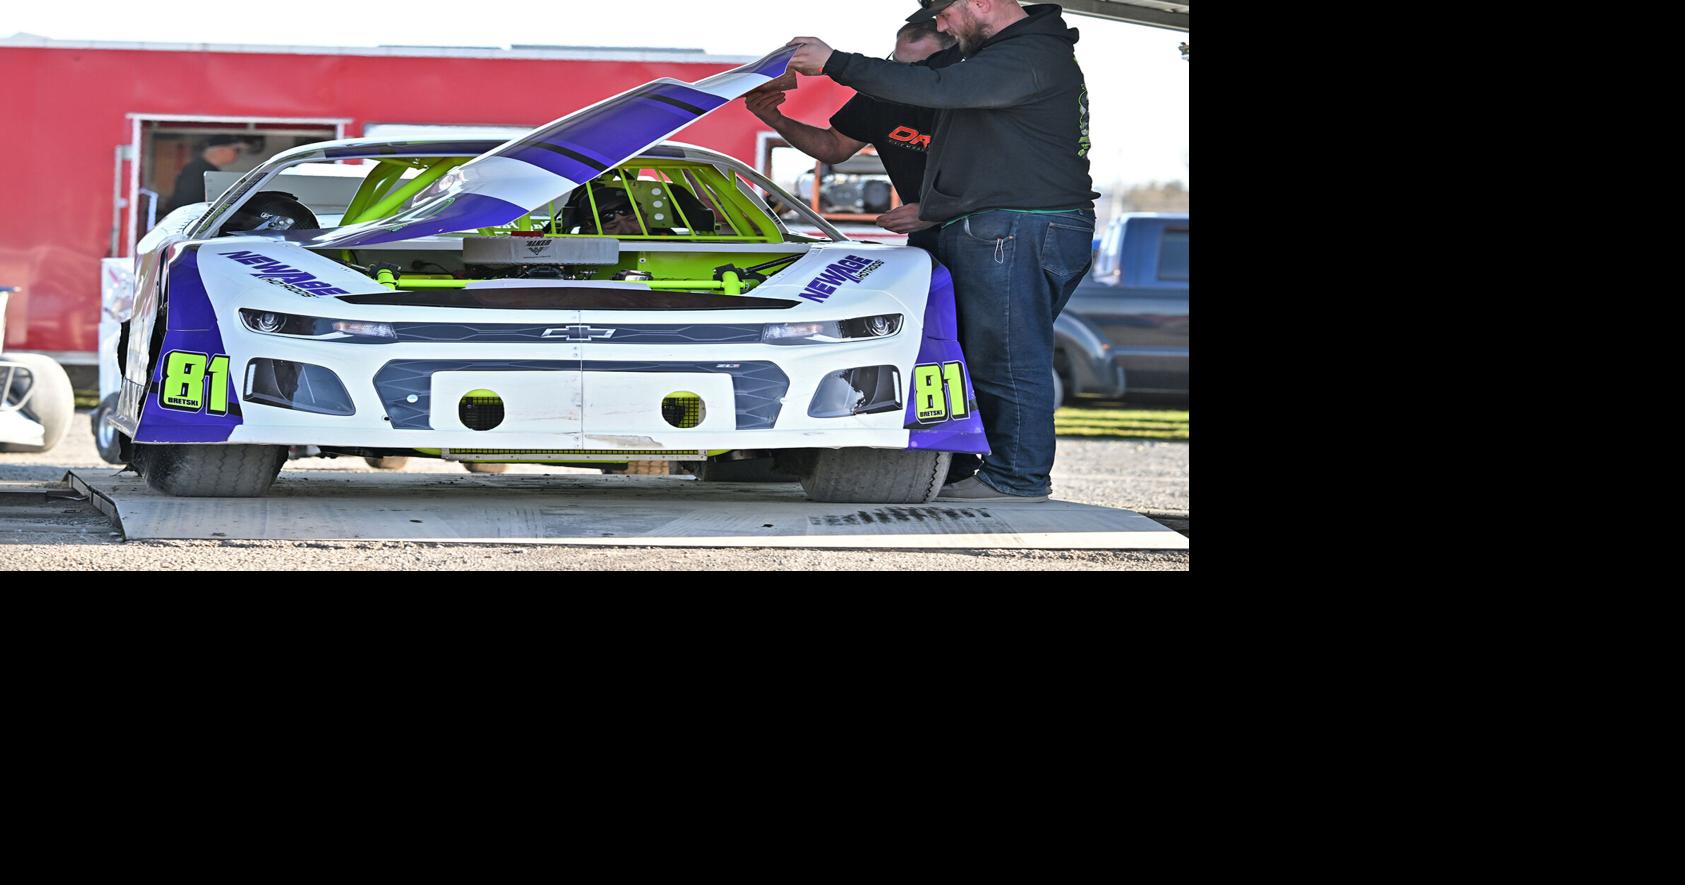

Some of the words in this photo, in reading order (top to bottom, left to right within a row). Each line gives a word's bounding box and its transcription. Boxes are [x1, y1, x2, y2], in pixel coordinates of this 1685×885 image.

[159, 350, 230, 415] 81
[914, 361, 969, 420] 81
[167, 396, 199, 407] BRETSKI
[919, 409, 943, 418] BRETSKI
